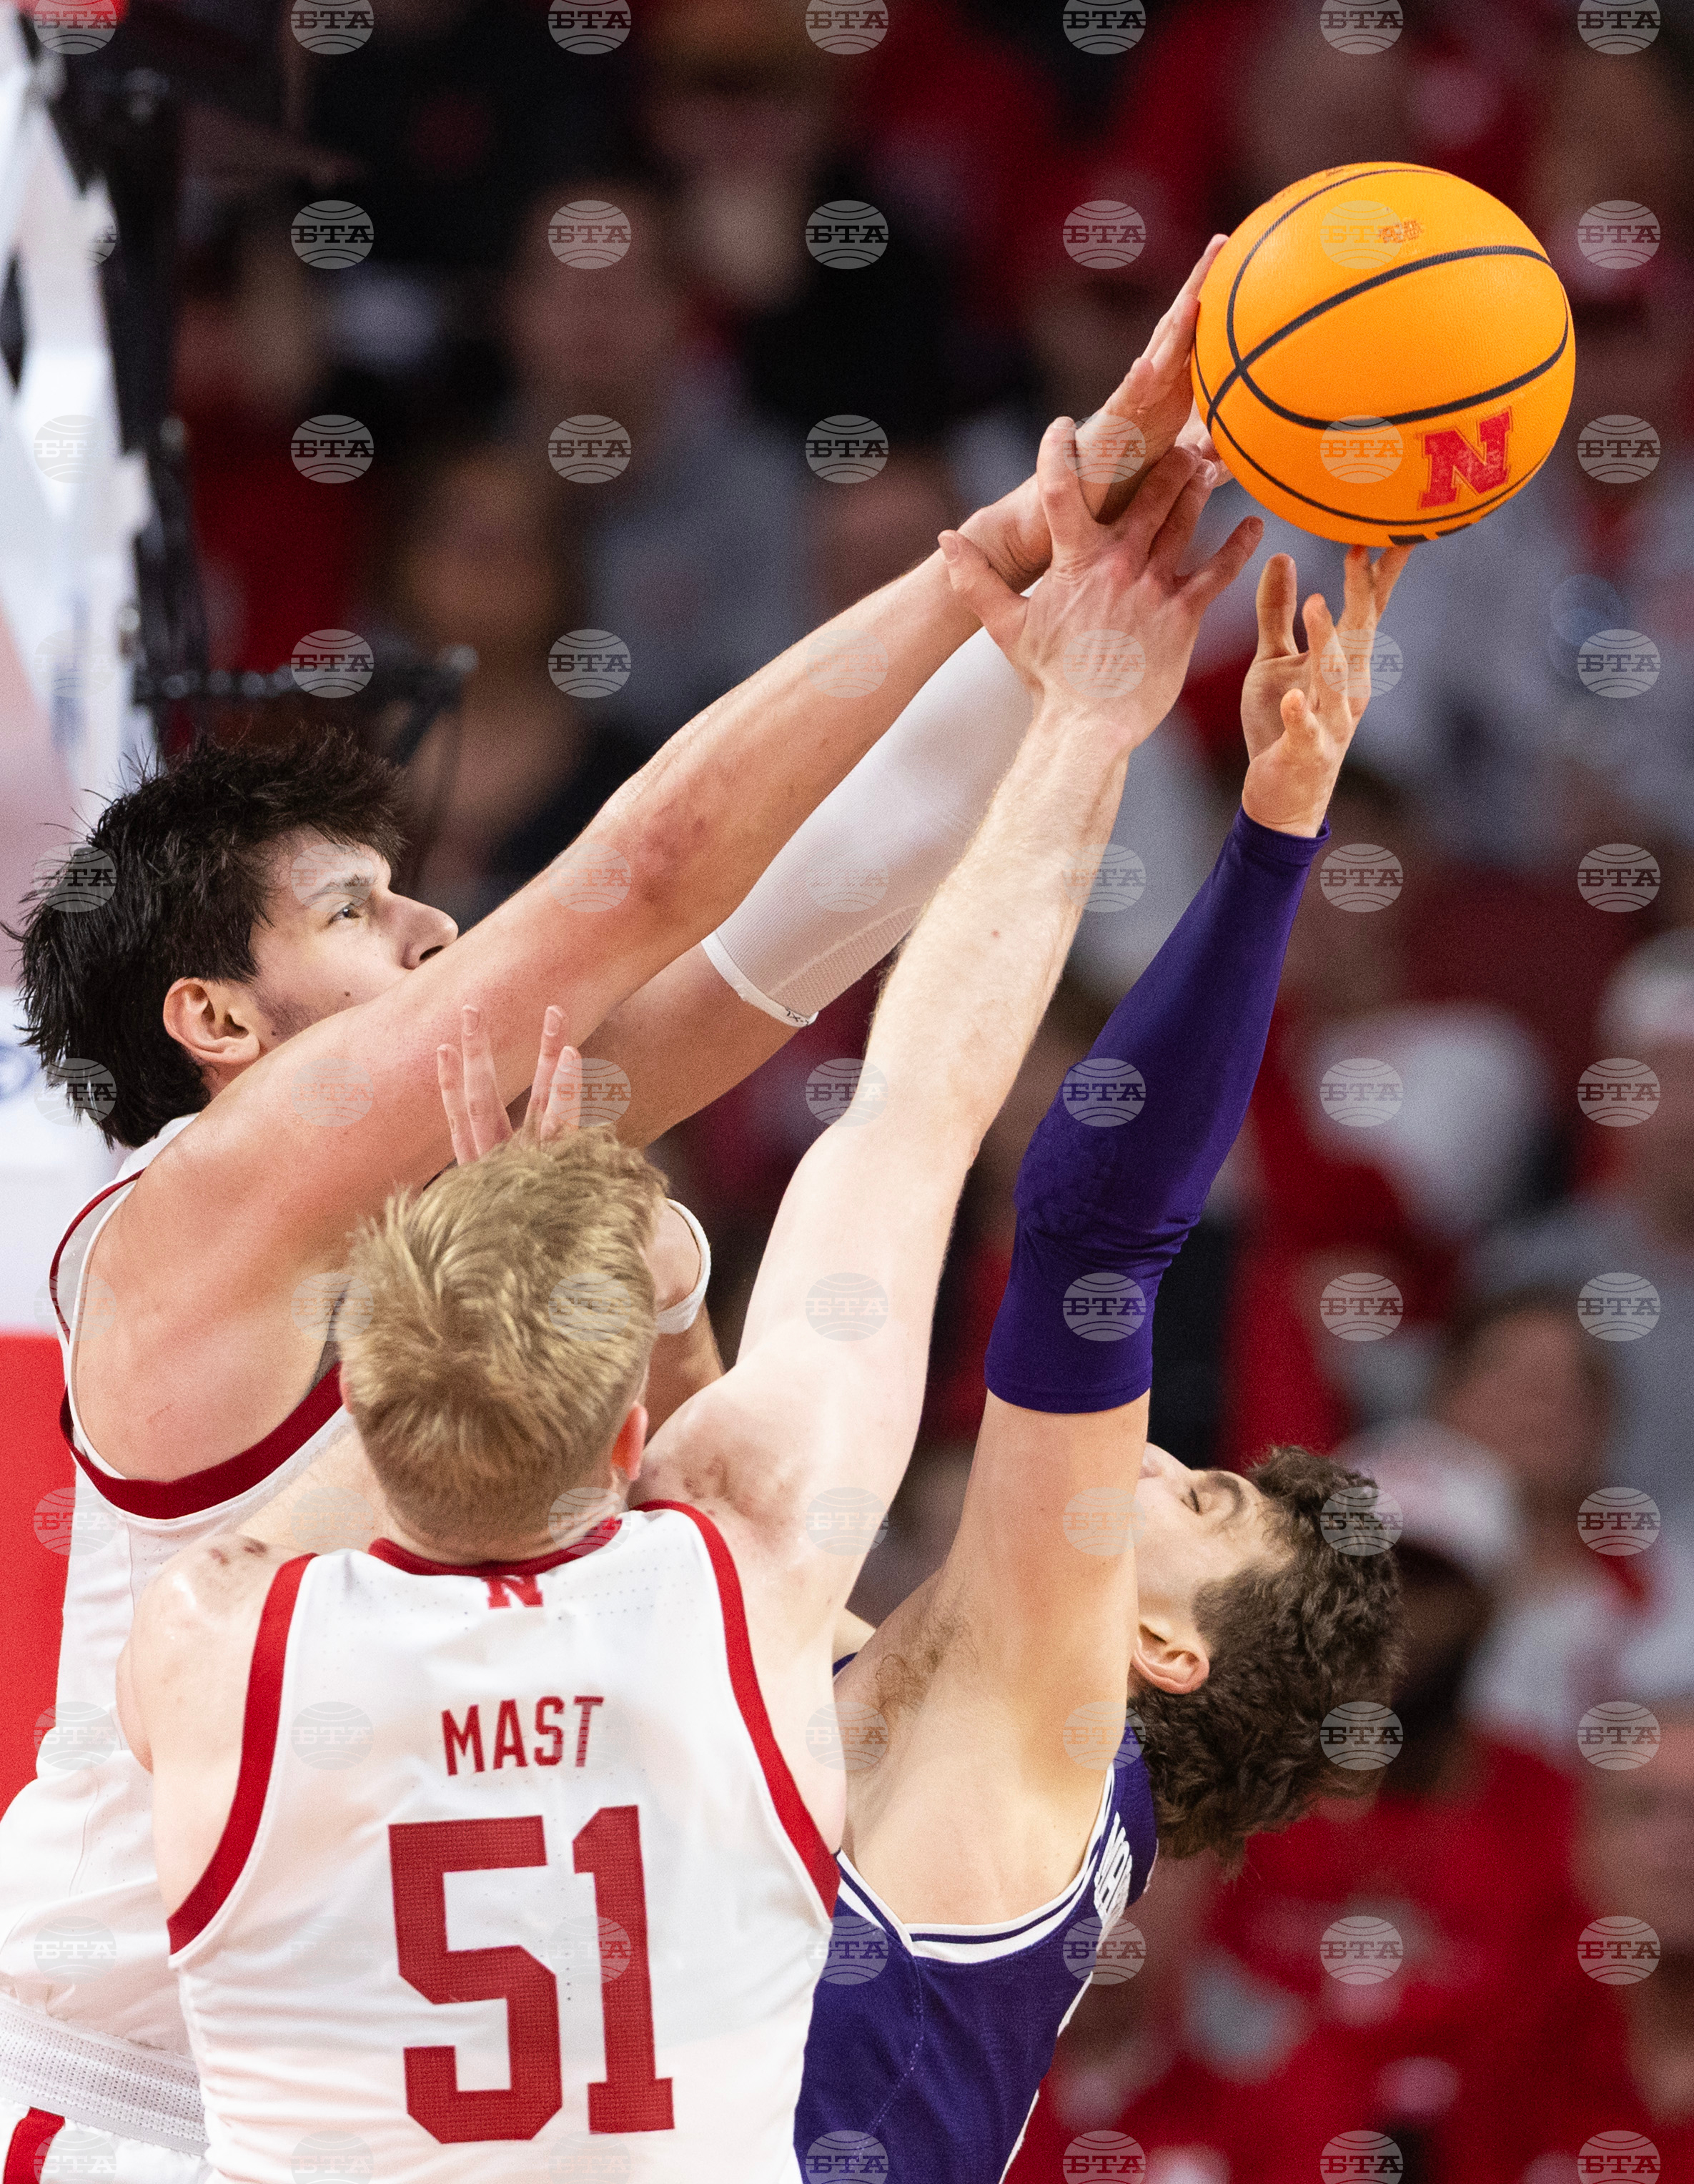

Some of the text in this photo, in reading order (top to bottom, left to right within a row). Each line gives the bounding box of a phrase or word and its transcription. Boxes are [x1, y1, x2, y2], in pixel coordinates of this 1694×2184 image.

[1418, 408, 1512, 510] N
[441, 1696, 604, 1777] MAST
[388, 1804, 675, 2144] 51
